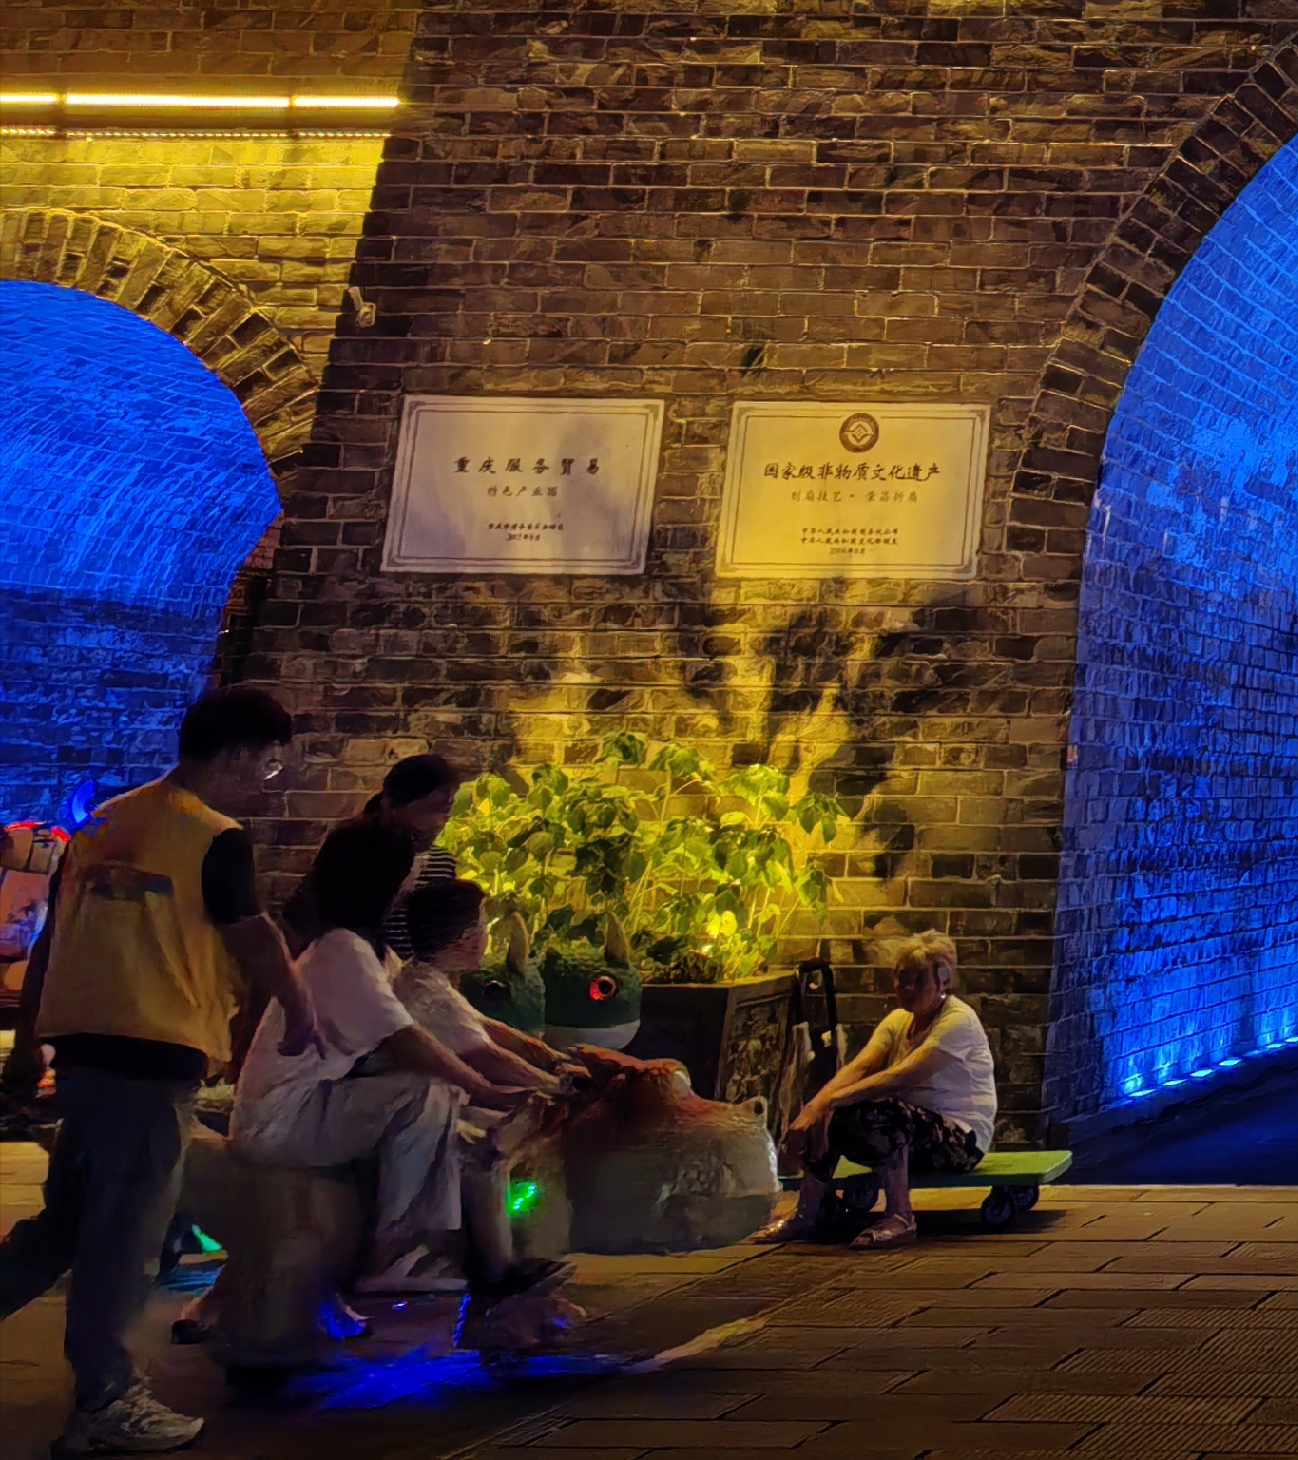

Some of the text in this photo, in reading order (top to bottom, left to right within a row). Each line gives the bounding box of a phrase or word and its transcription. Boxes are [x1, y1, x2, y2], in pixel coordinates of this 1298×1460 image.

[764, 461, 941, 482] 国家级非物质文化遗产
